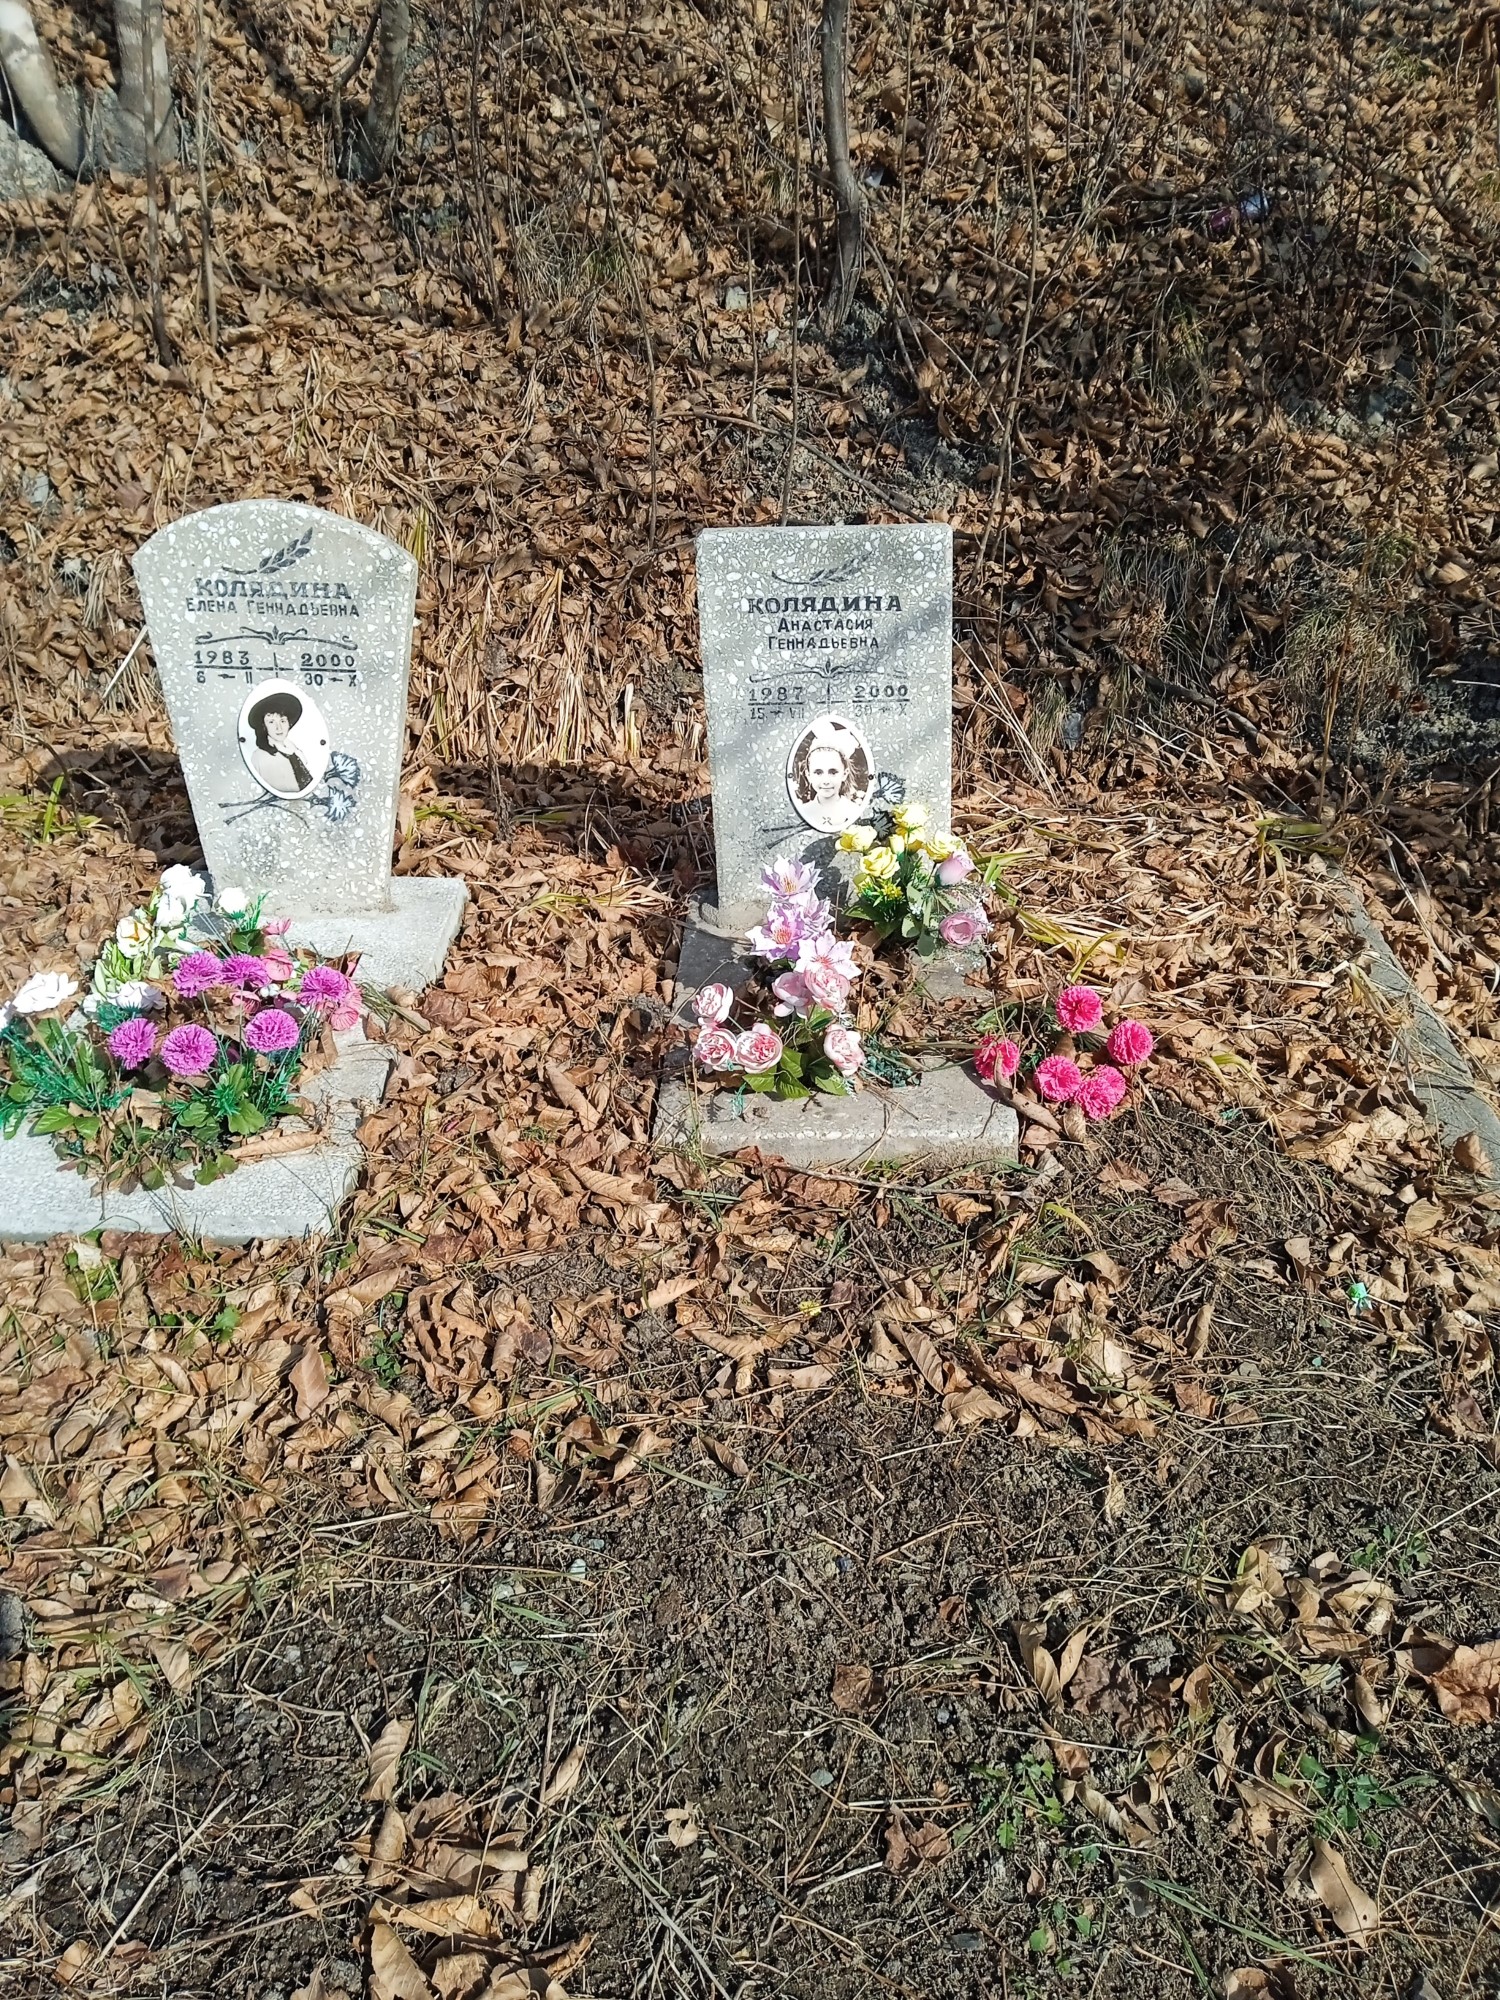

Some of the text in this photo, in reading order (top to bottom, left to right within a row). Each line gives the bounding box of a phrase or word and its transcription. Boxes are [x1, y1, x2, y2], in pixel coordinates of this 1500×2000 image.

[195, 578, 351, 599] КОЛЯДИНА
[186, 597, 359, 617] ЕЛЕНА ГЕННАДЬЕВНА
[748, 595, 902, 614] КОЛЯДИНА
[768, 636, 879, 650] ГЕННАДЬЕВНА
[194, 650, 355, 667] 1983 2000
[749, 685, 908, 701] 1987 2000
